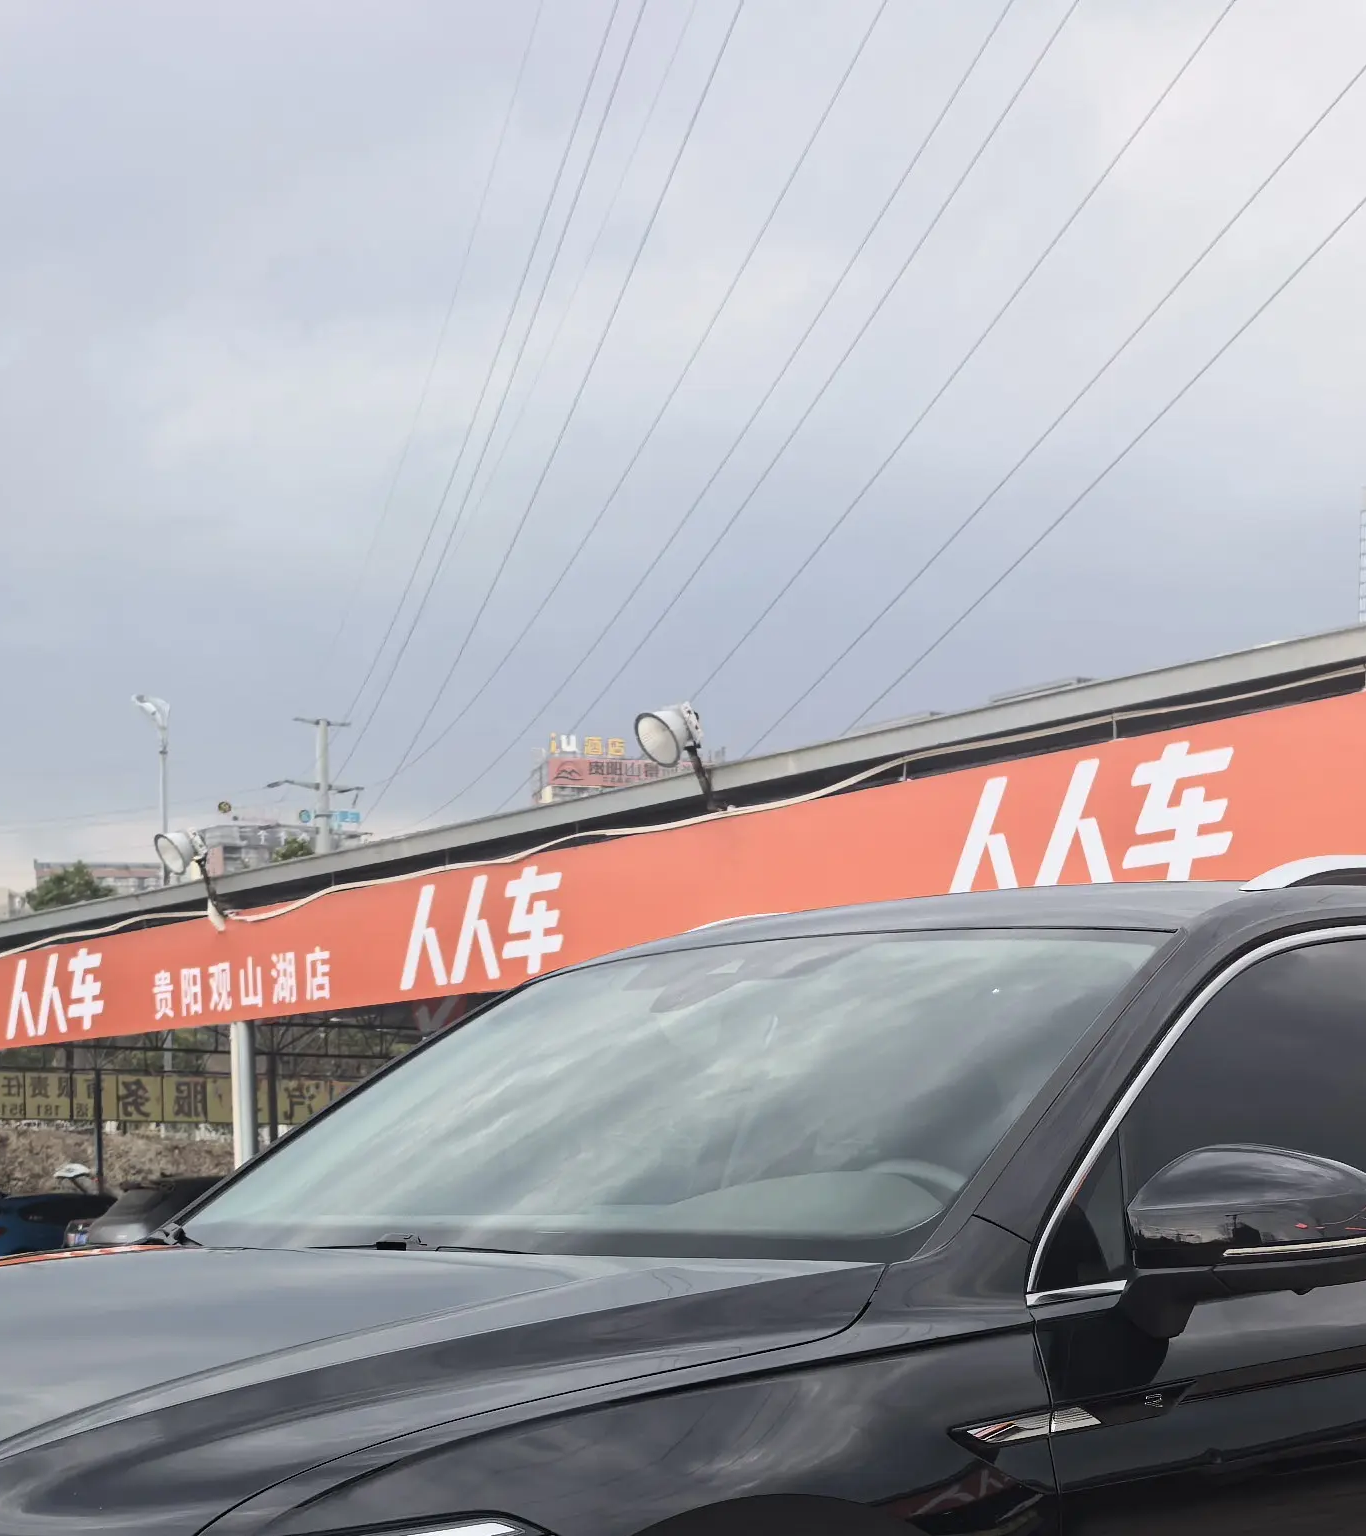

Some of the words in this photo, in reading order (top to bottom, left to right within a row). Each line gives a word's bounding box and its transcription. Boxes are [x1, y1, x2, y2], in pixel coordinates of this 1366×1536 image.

[948, 739, 1234, 893] 人人车
[399, 864, 563, 991] 人人车
[5, 947, 105, 1041] 人人车
[152, 945, 332, 1021] 贵阳观山湖店
